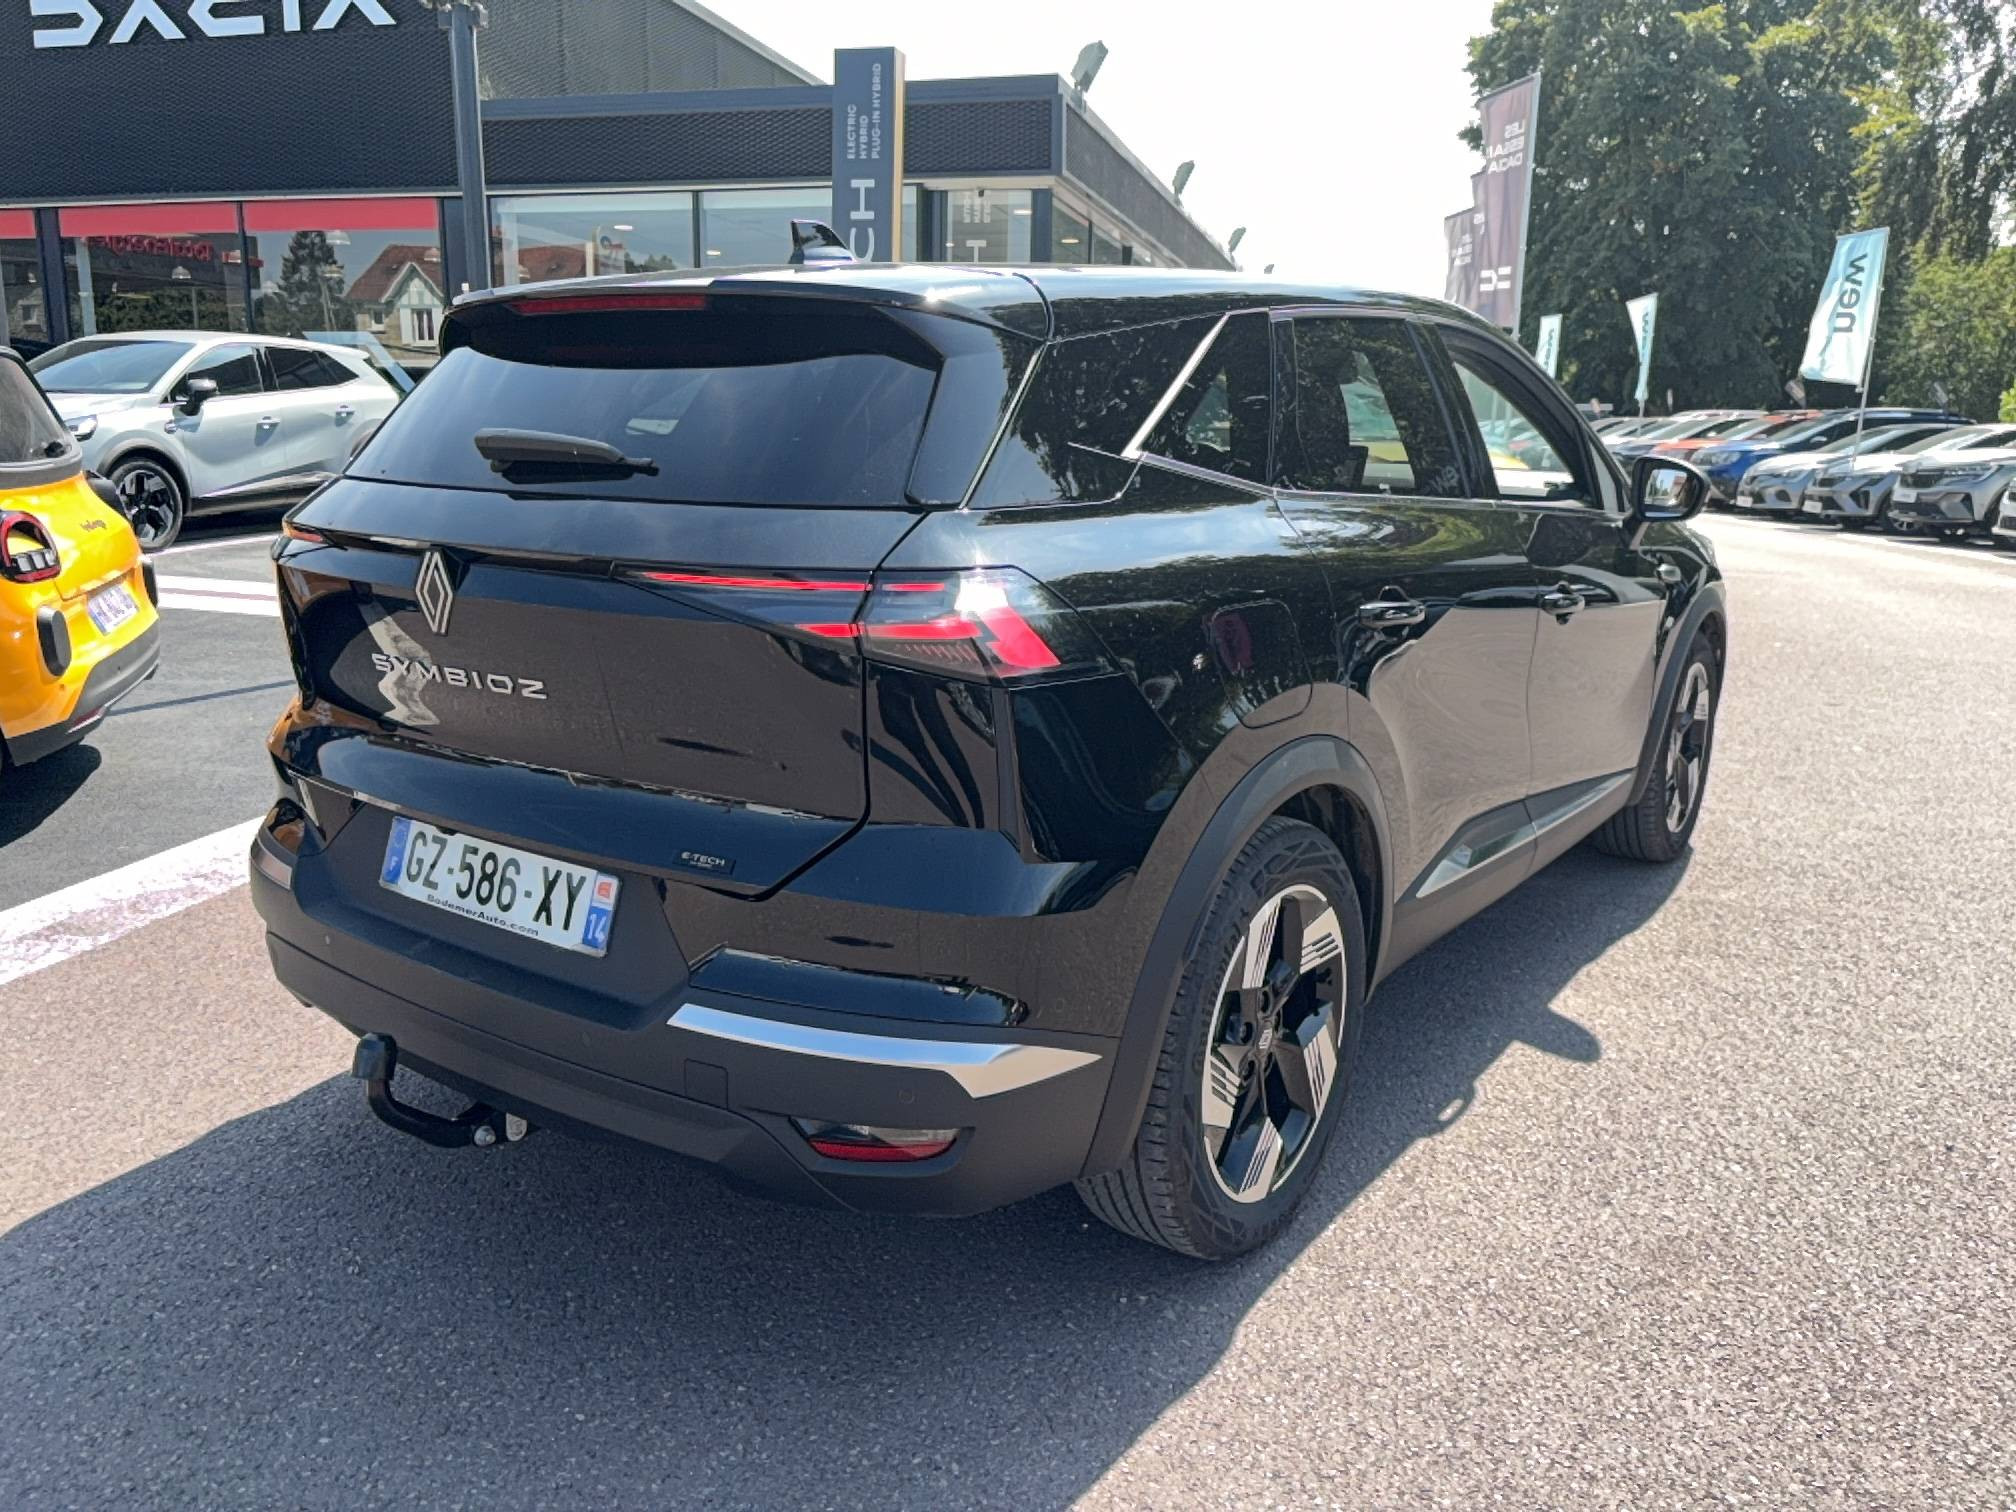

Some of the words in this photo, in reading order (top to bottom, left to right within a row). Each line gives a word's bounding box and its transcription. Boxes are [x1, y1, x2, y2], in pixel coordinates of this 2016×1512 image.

[872, 63, 882, 107] HYBRID
[847, 104, 857, 160] ELECTRIC
[859, 114, 869, 160] HYBRID
[871, 109, 882, 160] PLUG-IN
[1833, 252, 1869, 334] new
[371, 652, 548, 700] SYMBIOZ
[405, 829, 587, 932] GZ-586-XY
[681, 850, 726, 868] E-TECH
[426, 893, 540, 937] BodemerAuto.com
[587, 912, 607, 944] 14
